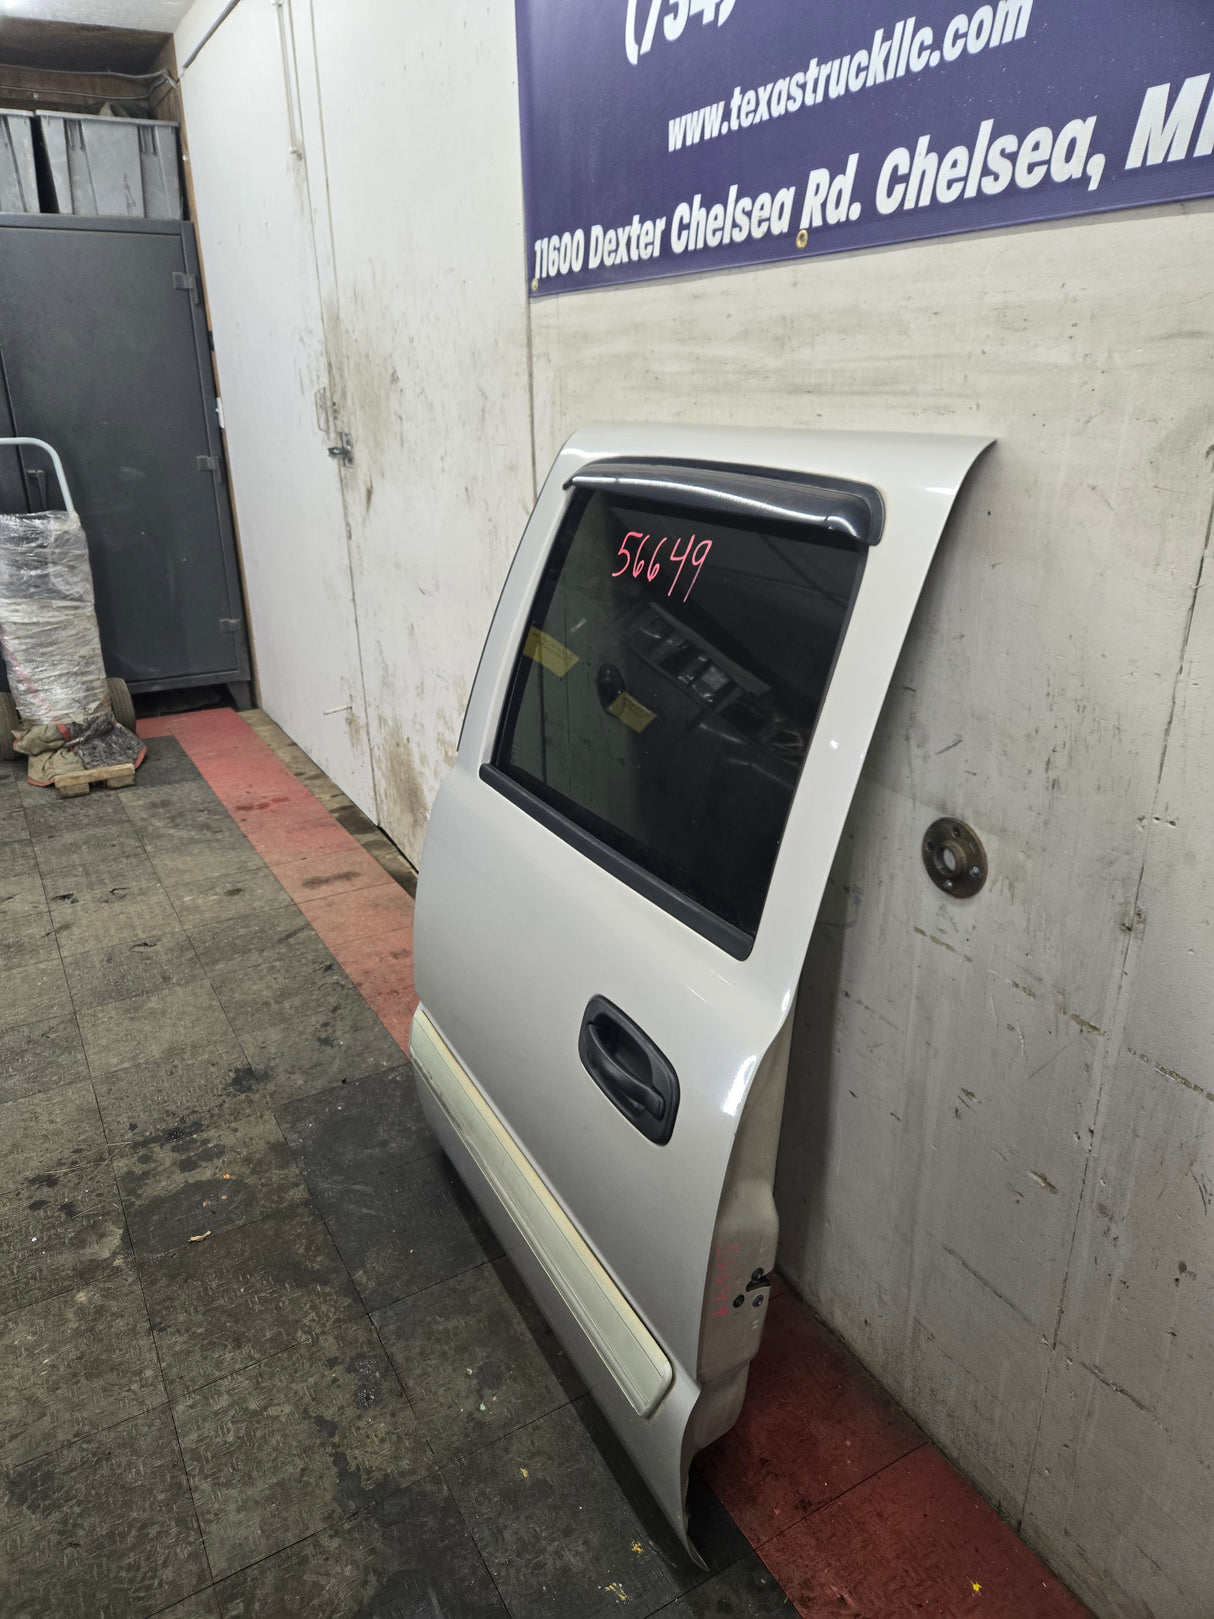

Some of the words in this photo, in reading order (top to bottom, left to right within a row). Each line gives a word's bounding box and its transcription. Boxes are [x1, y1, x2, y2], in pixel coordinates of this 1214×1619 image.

[668, 0, 1033, 152] www.texastruckllc.com
[534, 228, 585, 279] 11600
[589, 215, 666, 269] Dexter
[671, 184, 796, 254] Chelsea
[800, 153, 862, 230] Rd.
[876, 115, 1105, 215] Chelsea,
[611, 531, 713, 603] 56649
